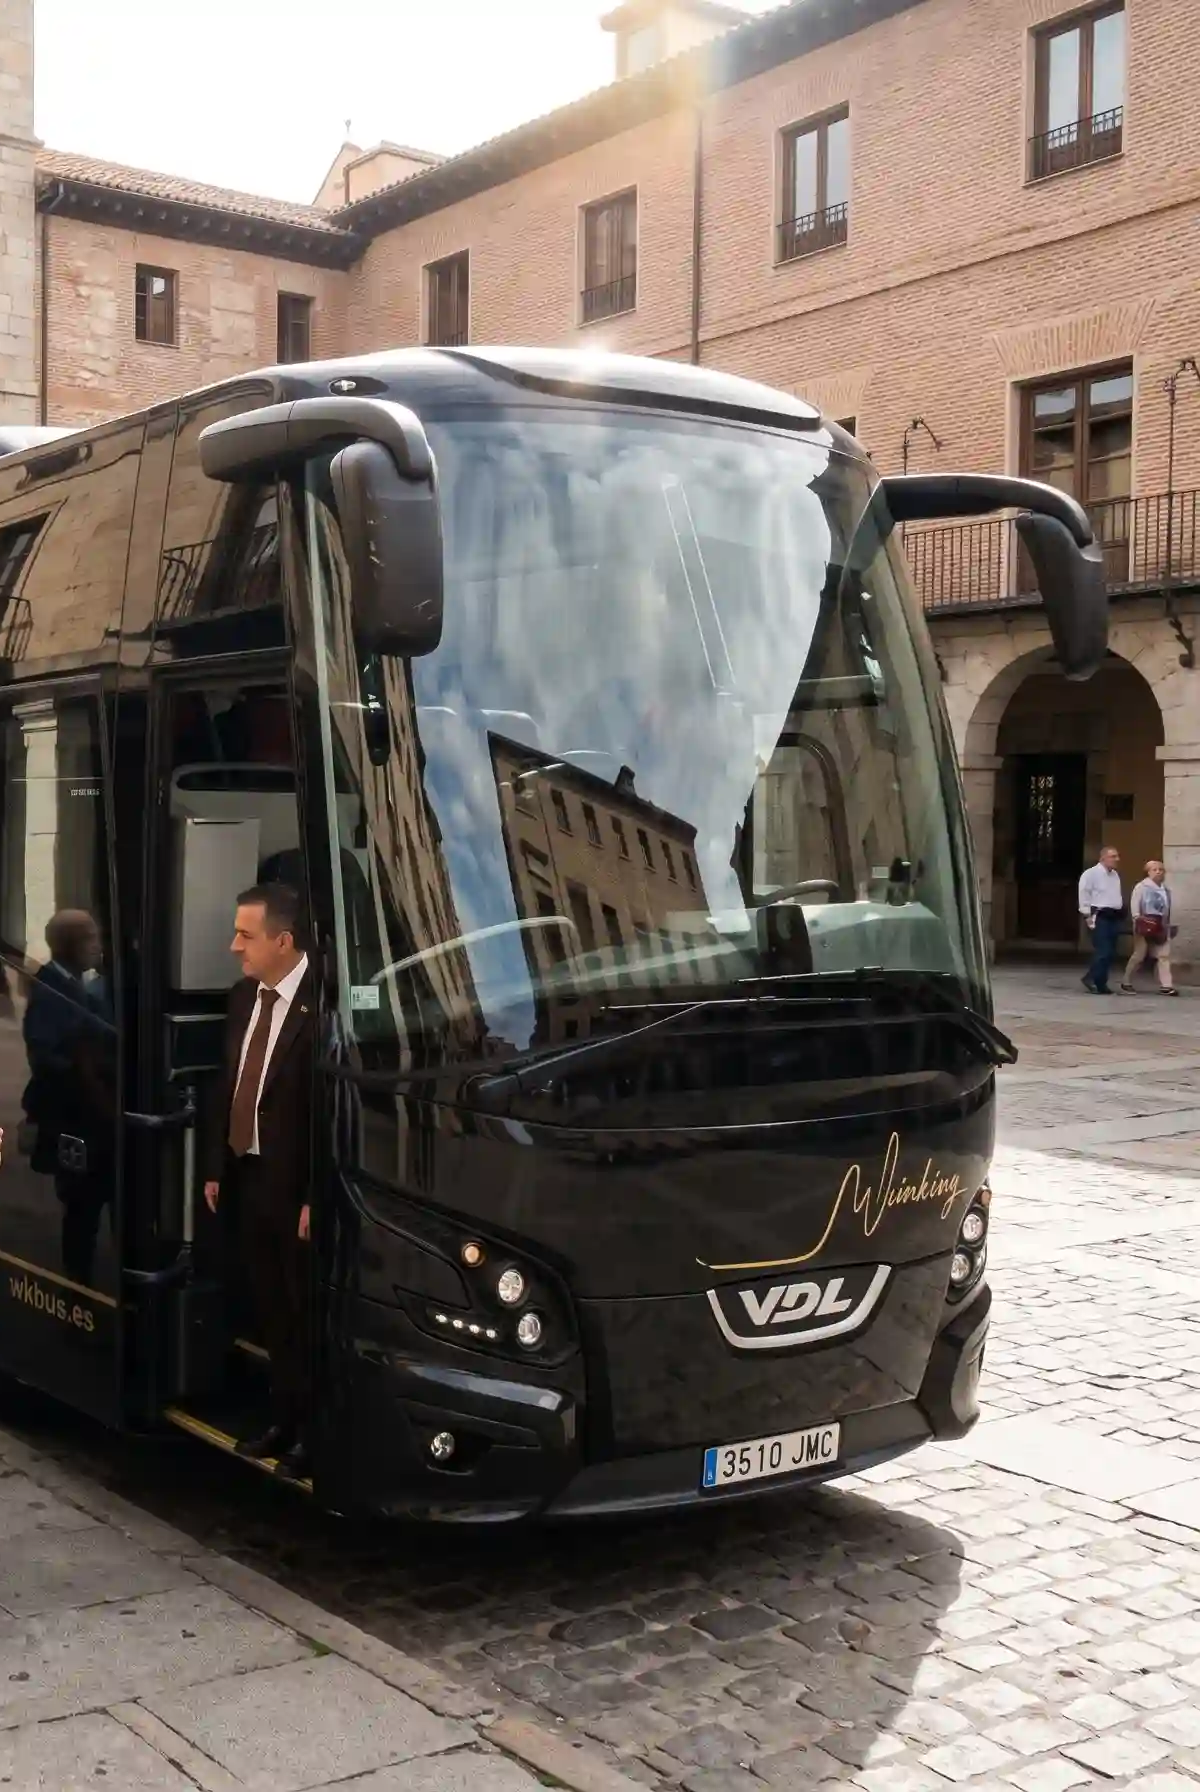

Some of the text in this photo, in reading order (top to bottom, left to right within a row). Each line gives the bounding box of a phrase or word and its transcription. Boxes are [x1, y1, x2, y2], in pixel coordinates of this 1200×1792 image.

[9, 1275, 95, 1332] wkbus.es
[738, 1277, 853, 1326] VDL
[722, 1430, 833, 1478] 3510 JMC
